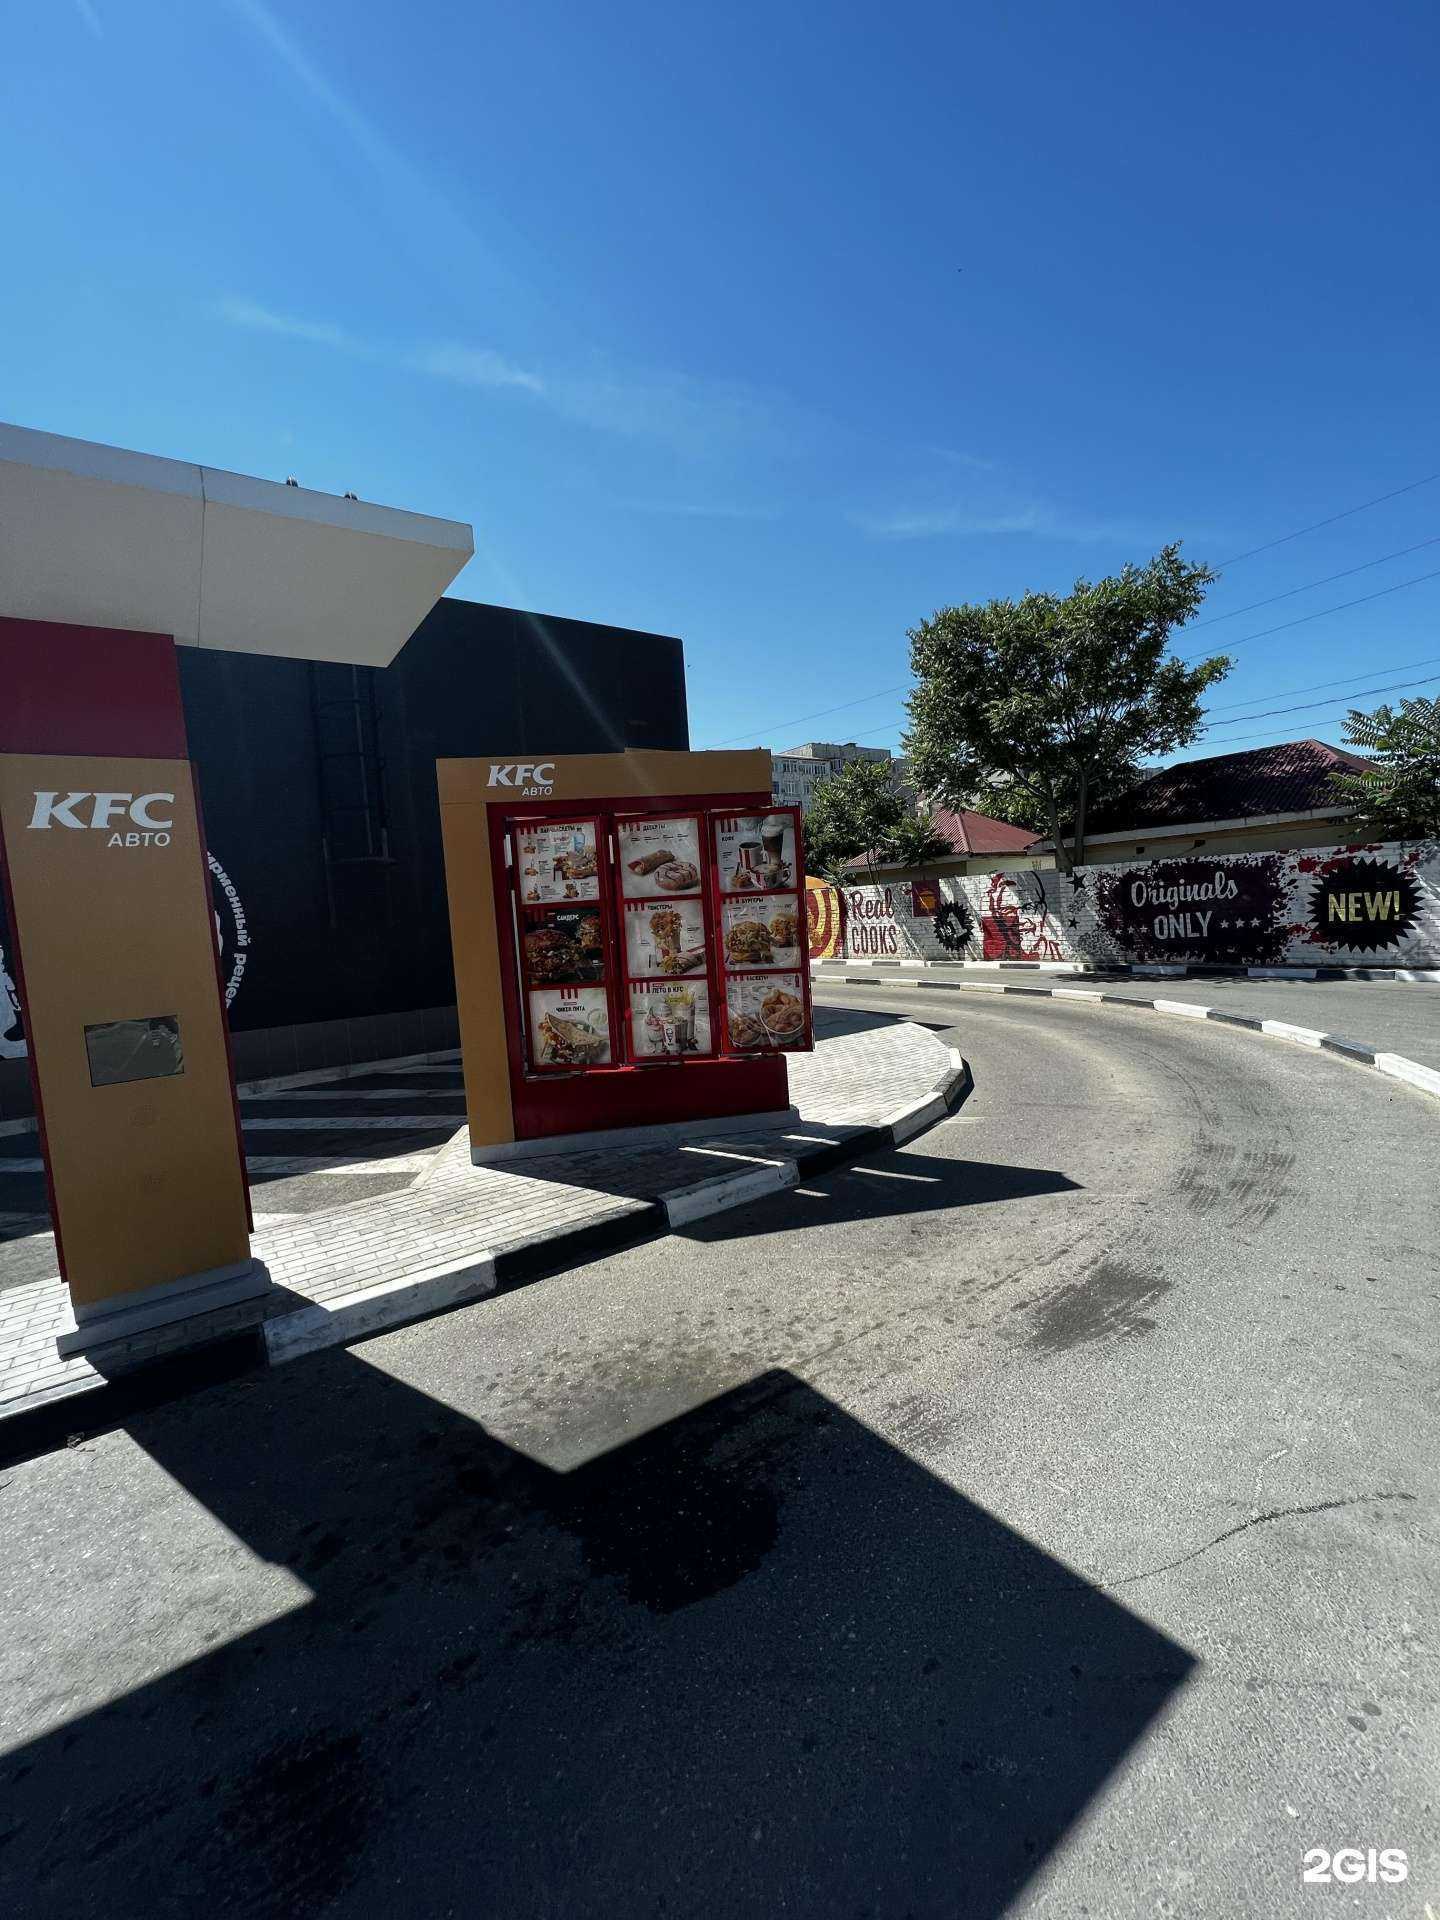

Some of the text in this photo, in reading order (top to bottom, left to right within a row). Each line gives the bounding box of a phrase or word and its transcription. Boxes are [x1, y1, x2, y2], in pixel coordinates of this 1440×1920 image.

[487, 763, 555, 787] KFC
[521, 786, 553, 796] АВТО
[27, 791, 174, 829] KFC
[107, 833, 171, 847] АВТО
[850, 887, 895, 920] Real
[1130, 871, 1239, 911] Originals
[1327, 890, 1400, 922] NEW!
[851, 925, 898, 955] COOKS
[1154, 911, 1213, 939] ONLY
